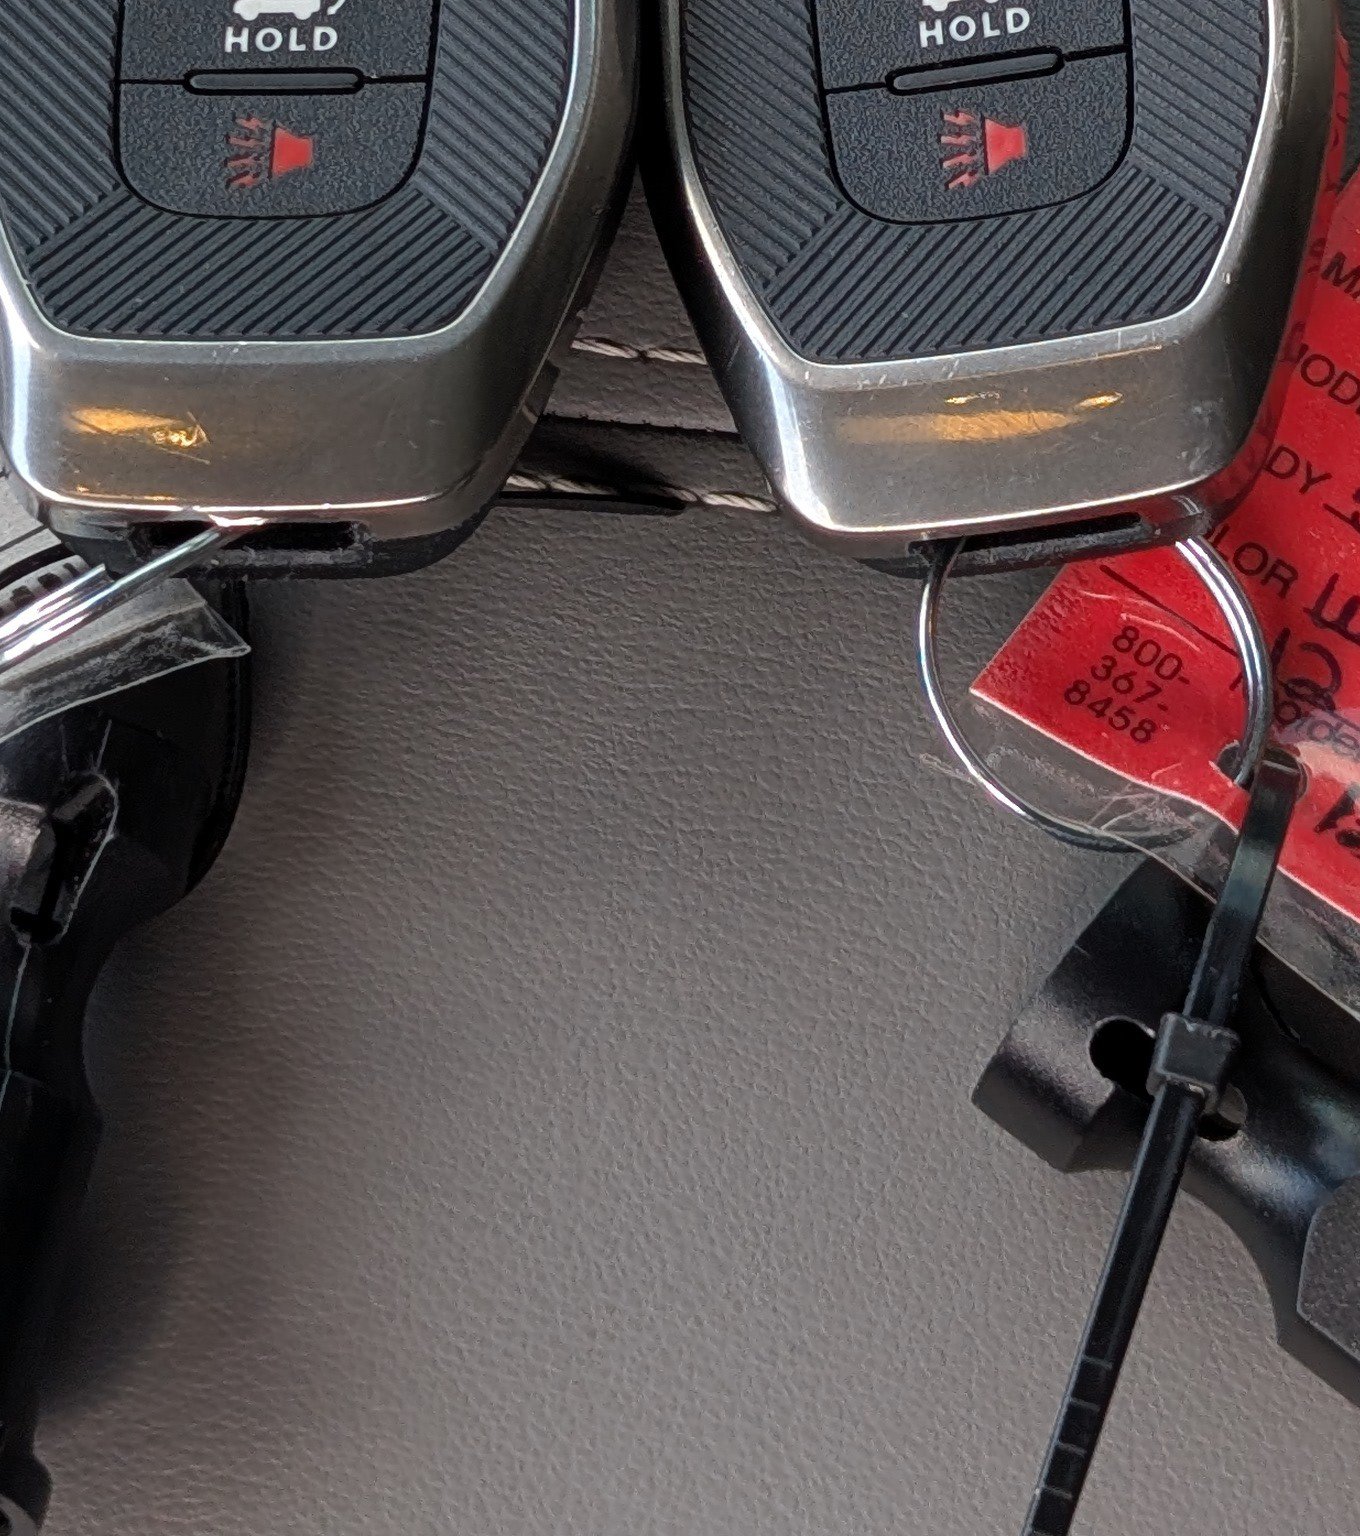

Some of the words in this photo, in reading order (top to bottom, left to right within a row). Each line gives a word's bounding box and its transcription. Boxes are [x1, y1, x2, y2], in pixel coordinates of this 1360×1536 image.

[224, 26, 338, 53] HOLD
[918, 7, 1031, 48] HOLD
[1264, 444, 1333, 495] DY
[1209, 524, 1300, 599] LOR
[1090, 654, 1169, 713] 367-
[1112, 624, 1190, 686] 800-
[1063, 679, 1157, 744] 8458
